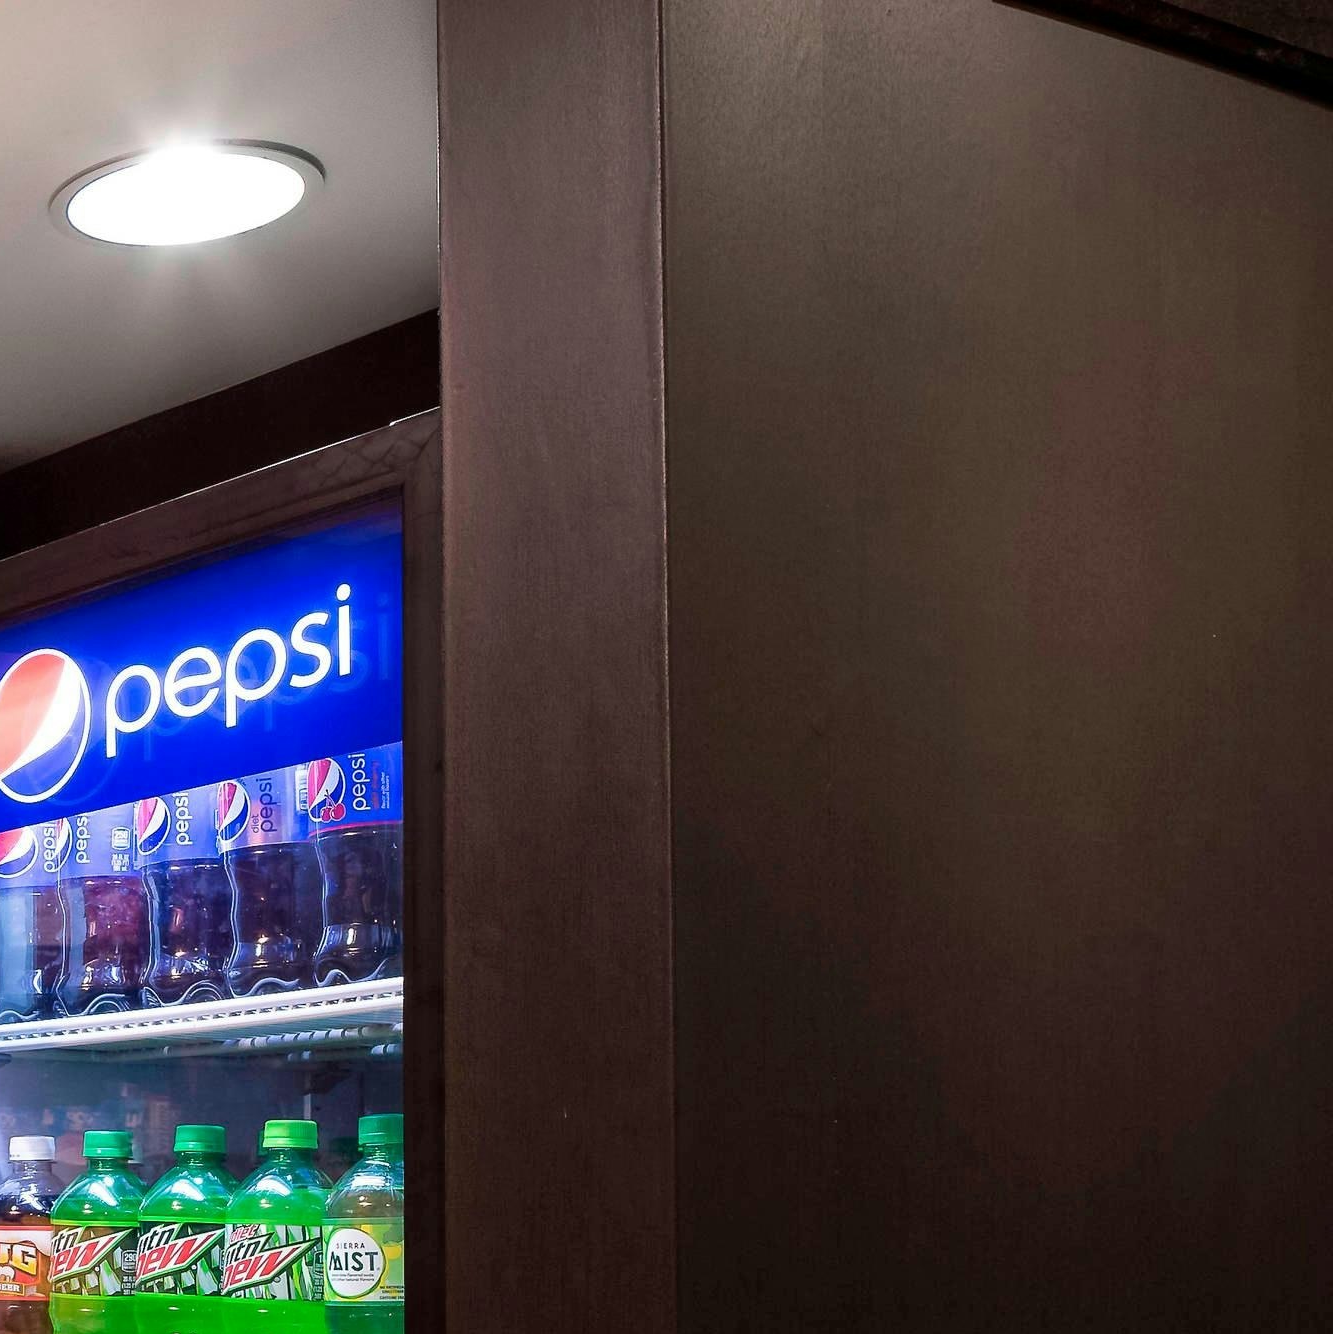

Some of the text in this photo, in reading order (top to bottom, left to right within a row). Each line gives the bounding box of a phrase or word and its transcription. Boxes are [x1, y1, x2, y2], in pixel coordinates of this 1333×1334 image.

[105, 583, 352, 758] pepsi
[256, 777, 278, 834] pepsi
[348, 753, 371, 811] pepsi
[251, 815, 259, 834] diet
[329, 1251, 378, 1272] MIST
